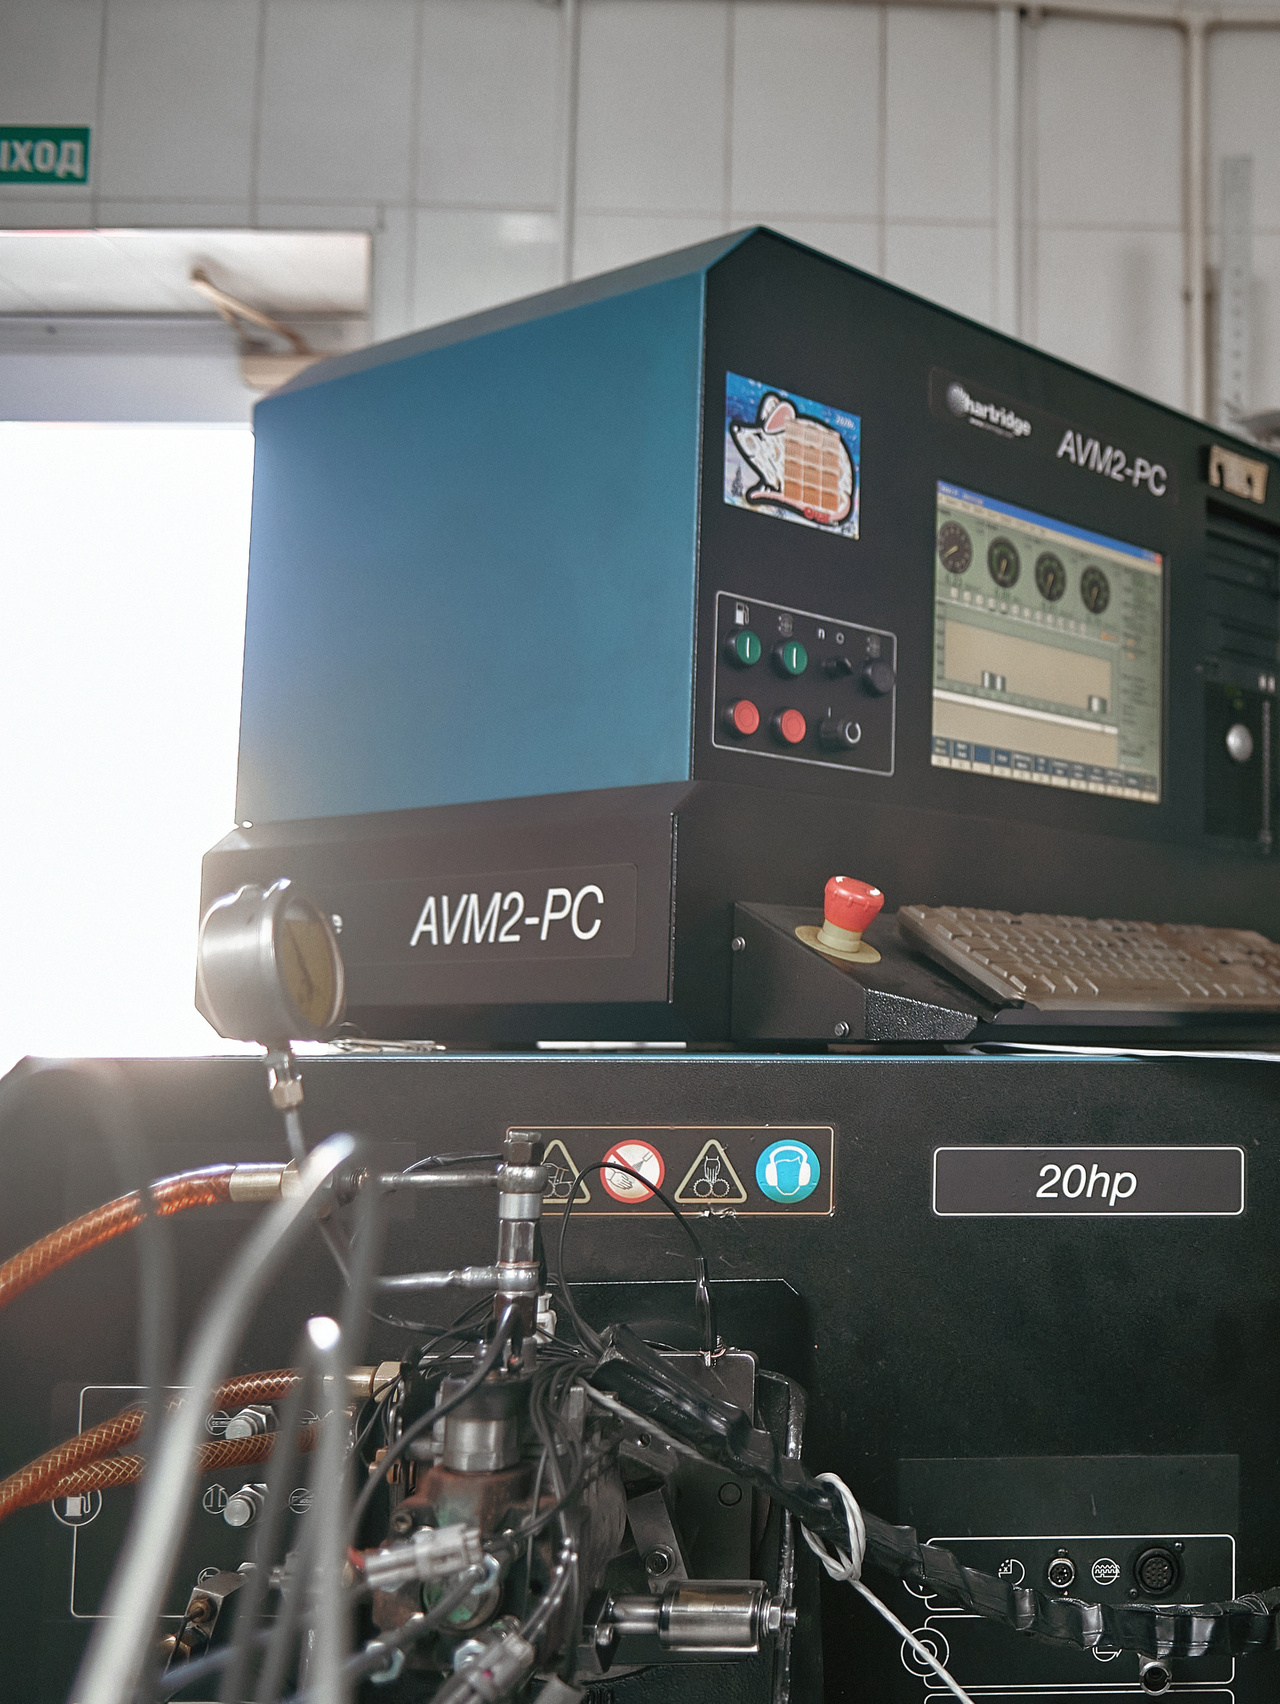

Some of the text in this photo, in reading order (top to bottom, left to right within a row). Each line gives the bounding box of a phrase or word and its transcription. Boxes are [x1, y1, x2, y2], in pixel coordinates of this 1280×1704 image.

[963, 390, 1032, 437] hartridge
[1056, 429, 1168, 498] AVM2-PC
[410, 884, 604, 946] AVM2-PC
[1036, 1164, 1138, 1207] 20hp
